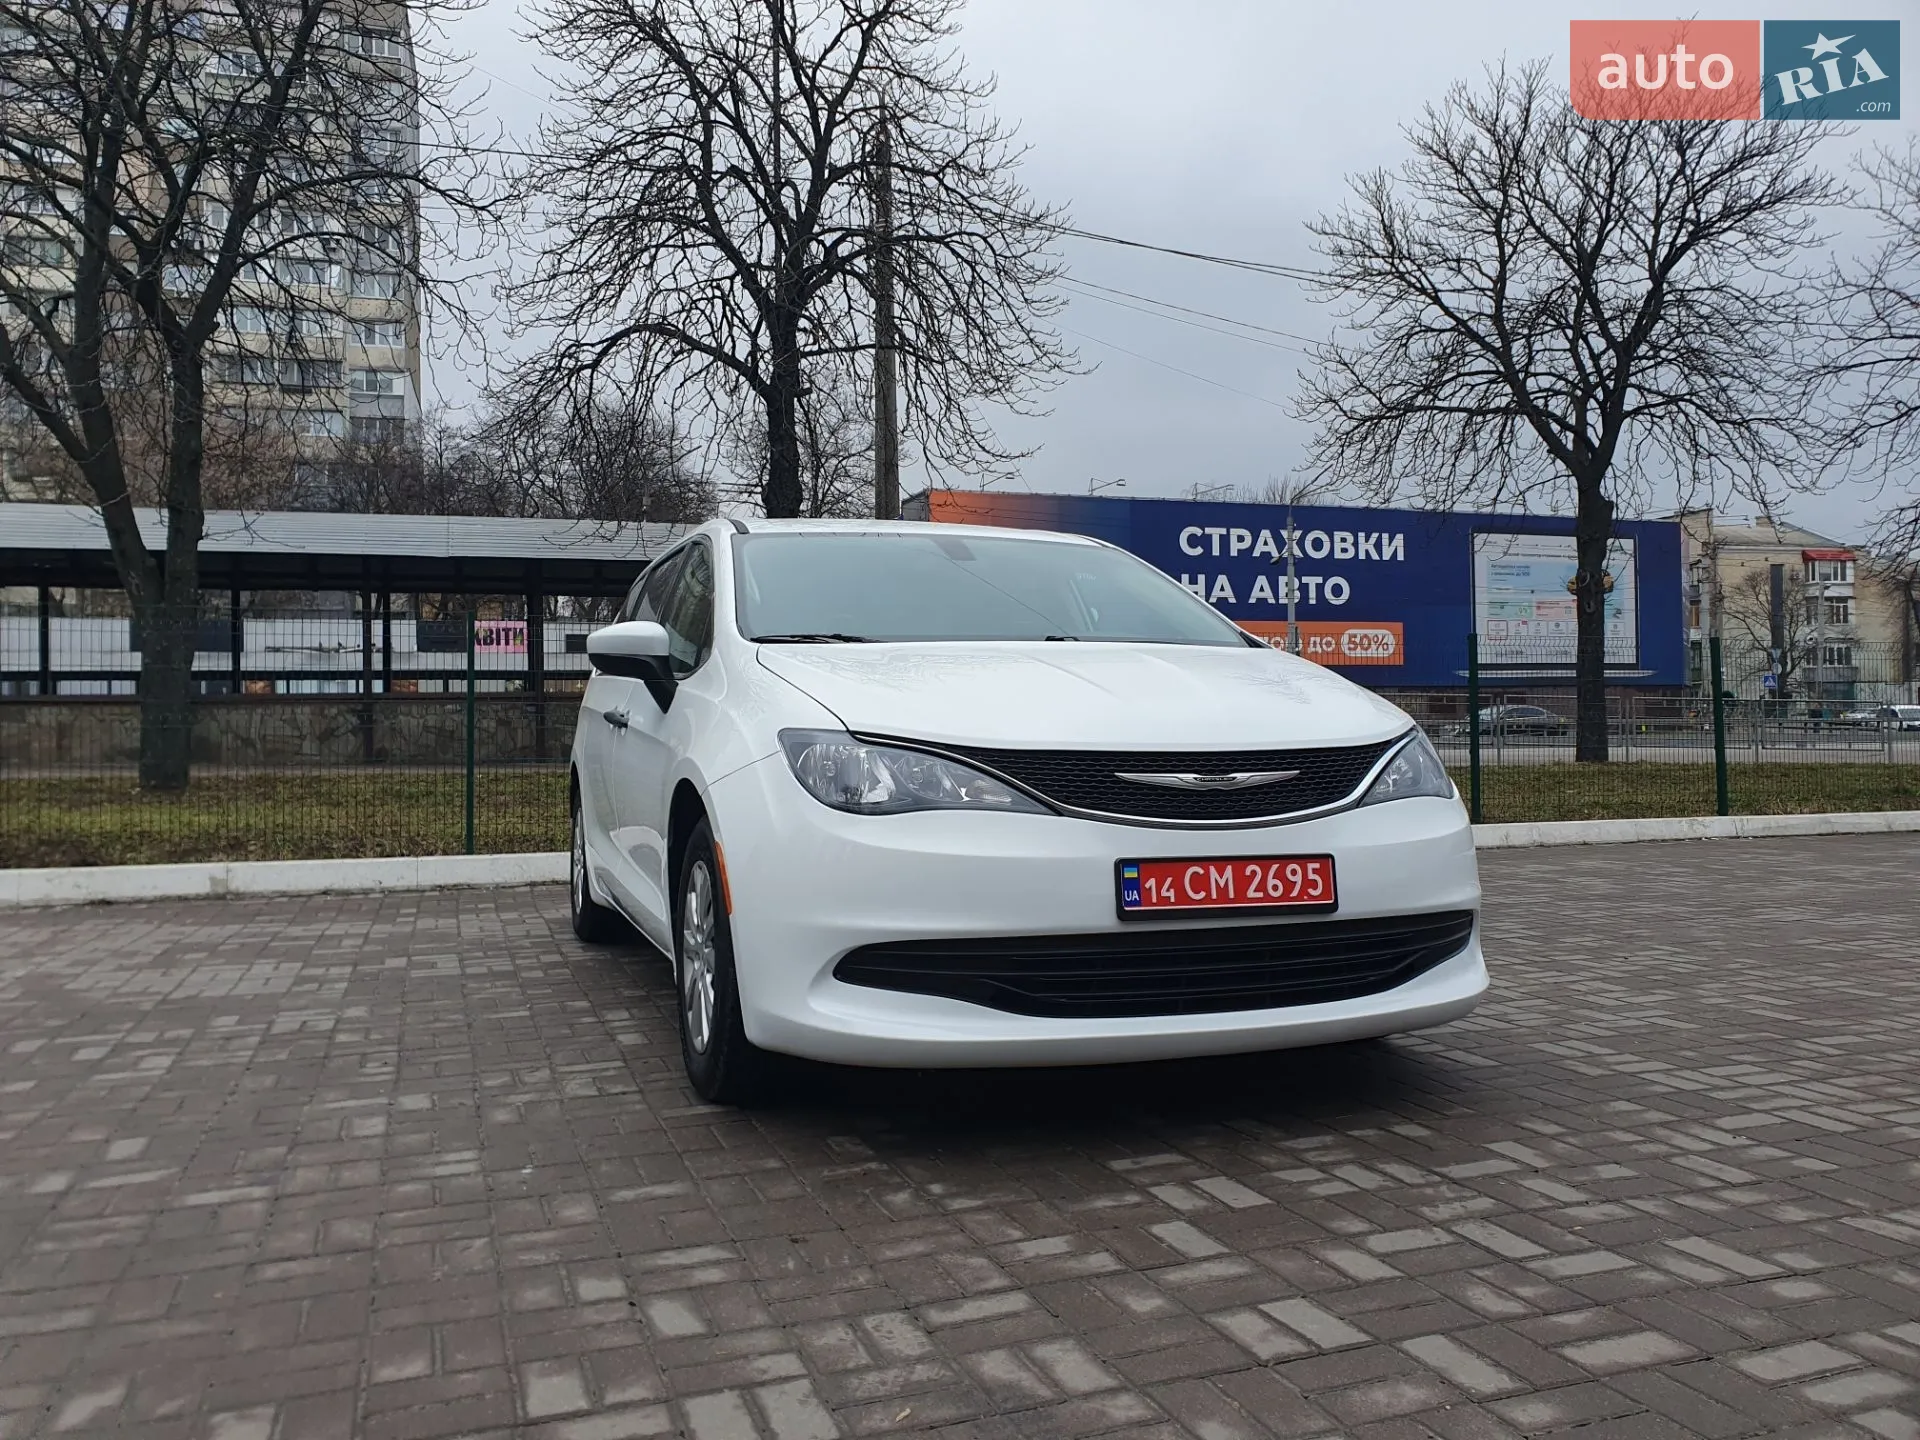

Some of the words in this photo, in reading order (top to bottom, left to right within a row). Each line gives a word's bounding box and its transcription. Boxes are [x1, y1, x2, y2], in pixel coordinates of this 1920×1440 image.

[1179, 526, 1405, 561] СТРАХОВКИ
[1181, 573, 1237, 604] НА
[1248, 575, 1351, 605] АВТО
[1347, 633, 1389, 652] 50%
[1124, 890, 1139, 901] UA
[1144, 877, 1175, 903] 14
[1184, 864, 1235, 900] CM
[1245, 862, 1323, 898] 2695
